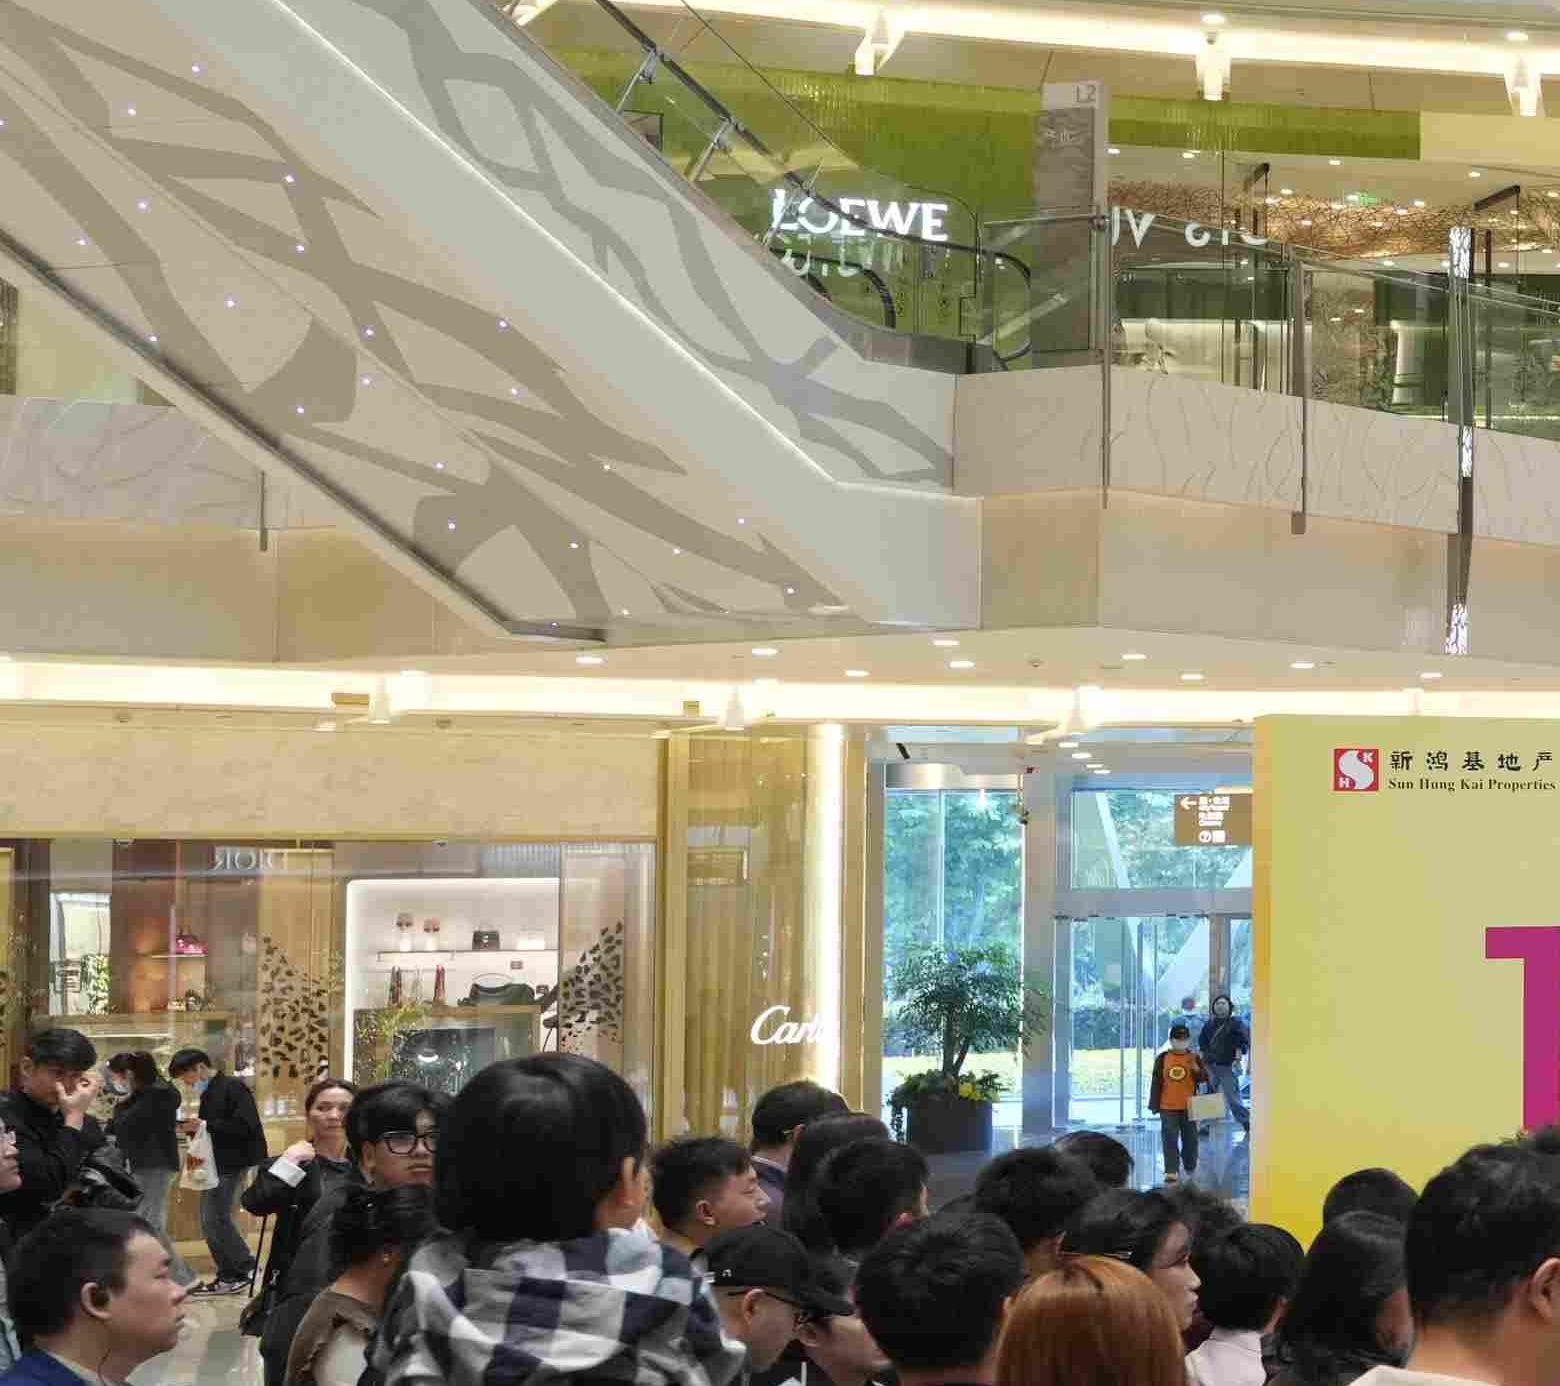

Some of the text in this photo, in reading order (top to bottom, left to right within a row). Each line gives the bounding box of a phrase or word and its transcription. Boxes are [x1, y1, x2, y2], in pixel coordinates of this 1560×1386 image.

[772, 188, 948, 241] LOEWE
[1389, 750, 1553, 771] 新鸿基地产
[1388, 778, 1556, 792] Sun Hung Kai Properties
